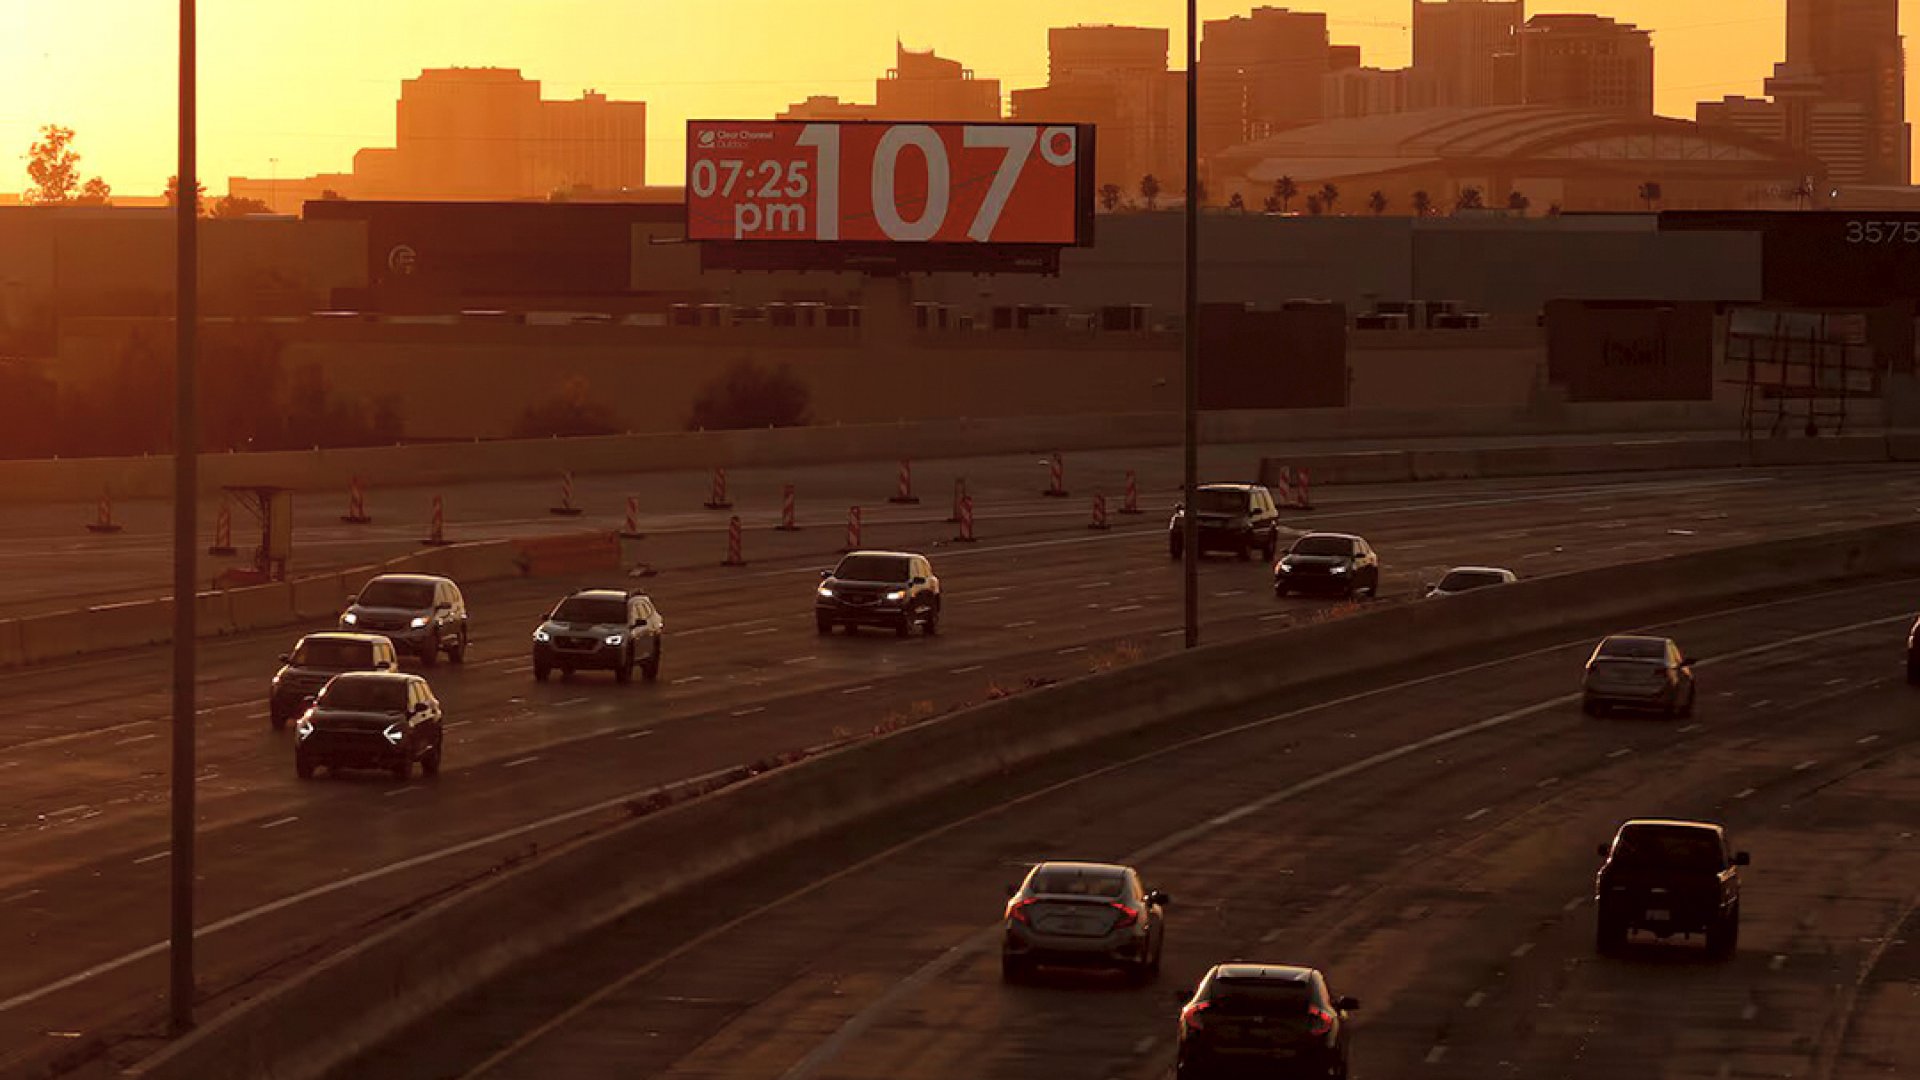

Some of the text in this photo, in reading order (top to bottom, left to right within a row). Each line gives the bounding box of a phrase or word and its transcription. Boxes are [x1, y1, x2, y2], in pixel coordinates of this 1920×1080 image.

[716, 130, 774, 139] Clear Channel
[692, 159, 808, 198] 07:25
[735, 203, 806, 240] pm
[1846, 222, 1920, 243] 3575
